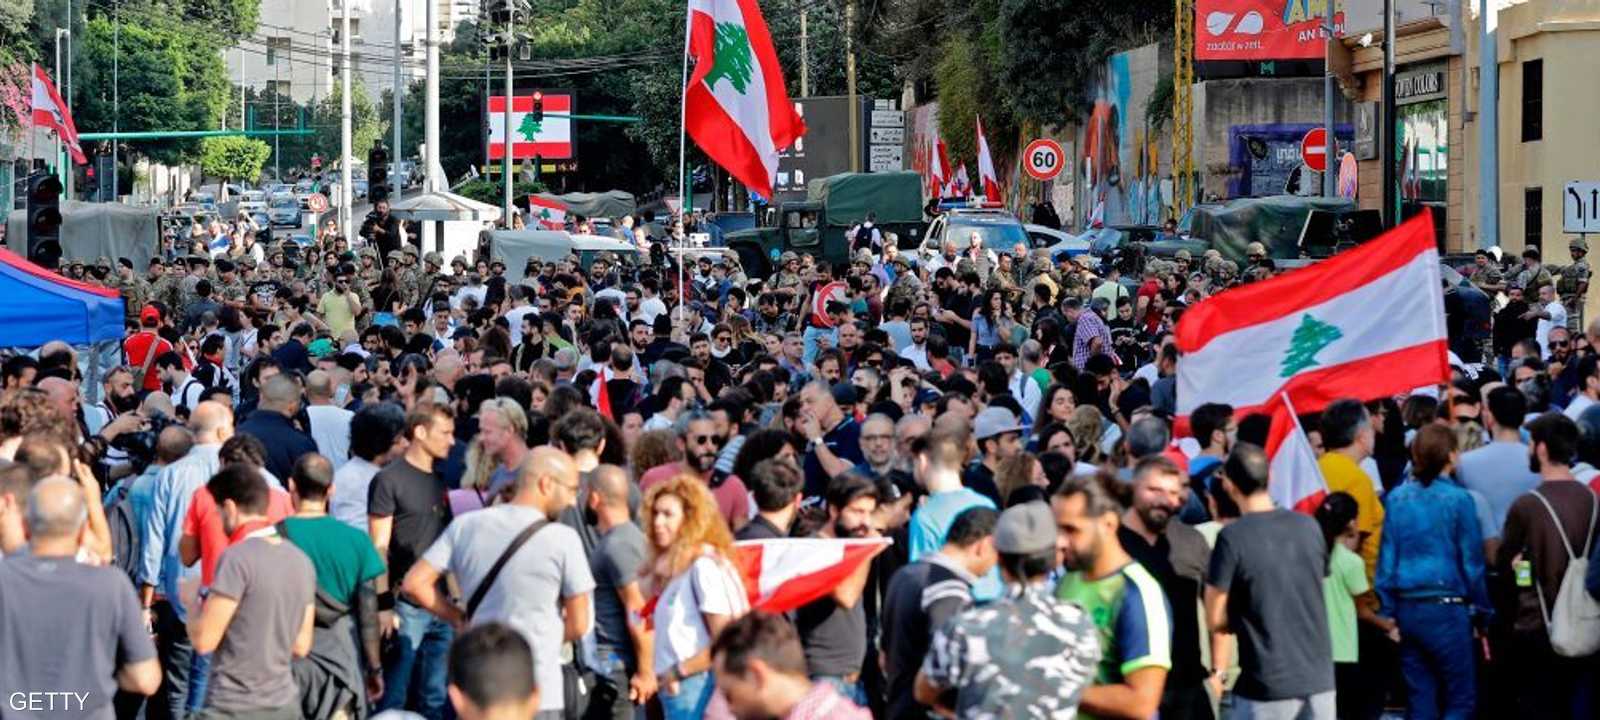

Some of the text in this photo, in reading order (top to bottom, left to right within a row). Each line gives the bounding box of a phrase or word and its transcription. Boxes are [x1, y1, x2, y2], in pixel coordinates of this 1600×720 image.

[1298, 28, 1316, 41] AN
[1414, 73, 1438, 94] COLORS
[1033, 151, 1055, 168] 60
